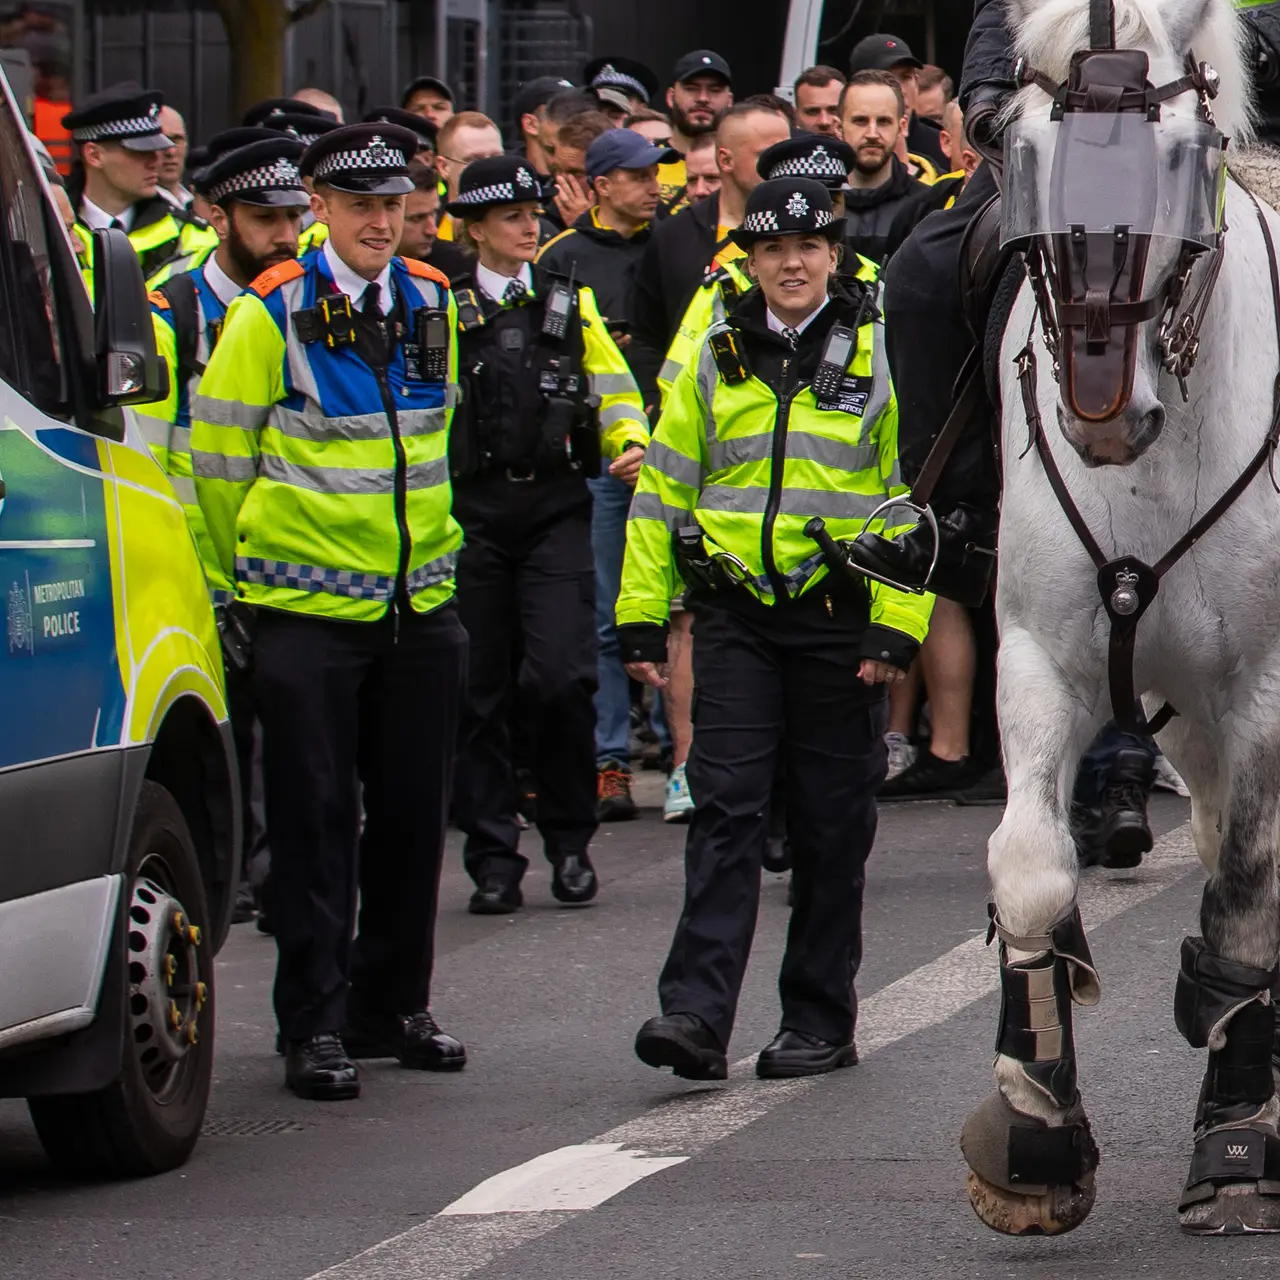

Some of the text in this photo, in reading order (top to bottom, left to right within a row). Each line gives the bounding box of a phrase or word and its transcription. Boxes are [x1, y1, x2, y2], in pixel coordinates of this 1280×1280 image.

[838, 403, 862, 415] OFFICER
[33, 580, 85, 605] METROPOLITAN
[43, 611, 81, 638] POLICE
